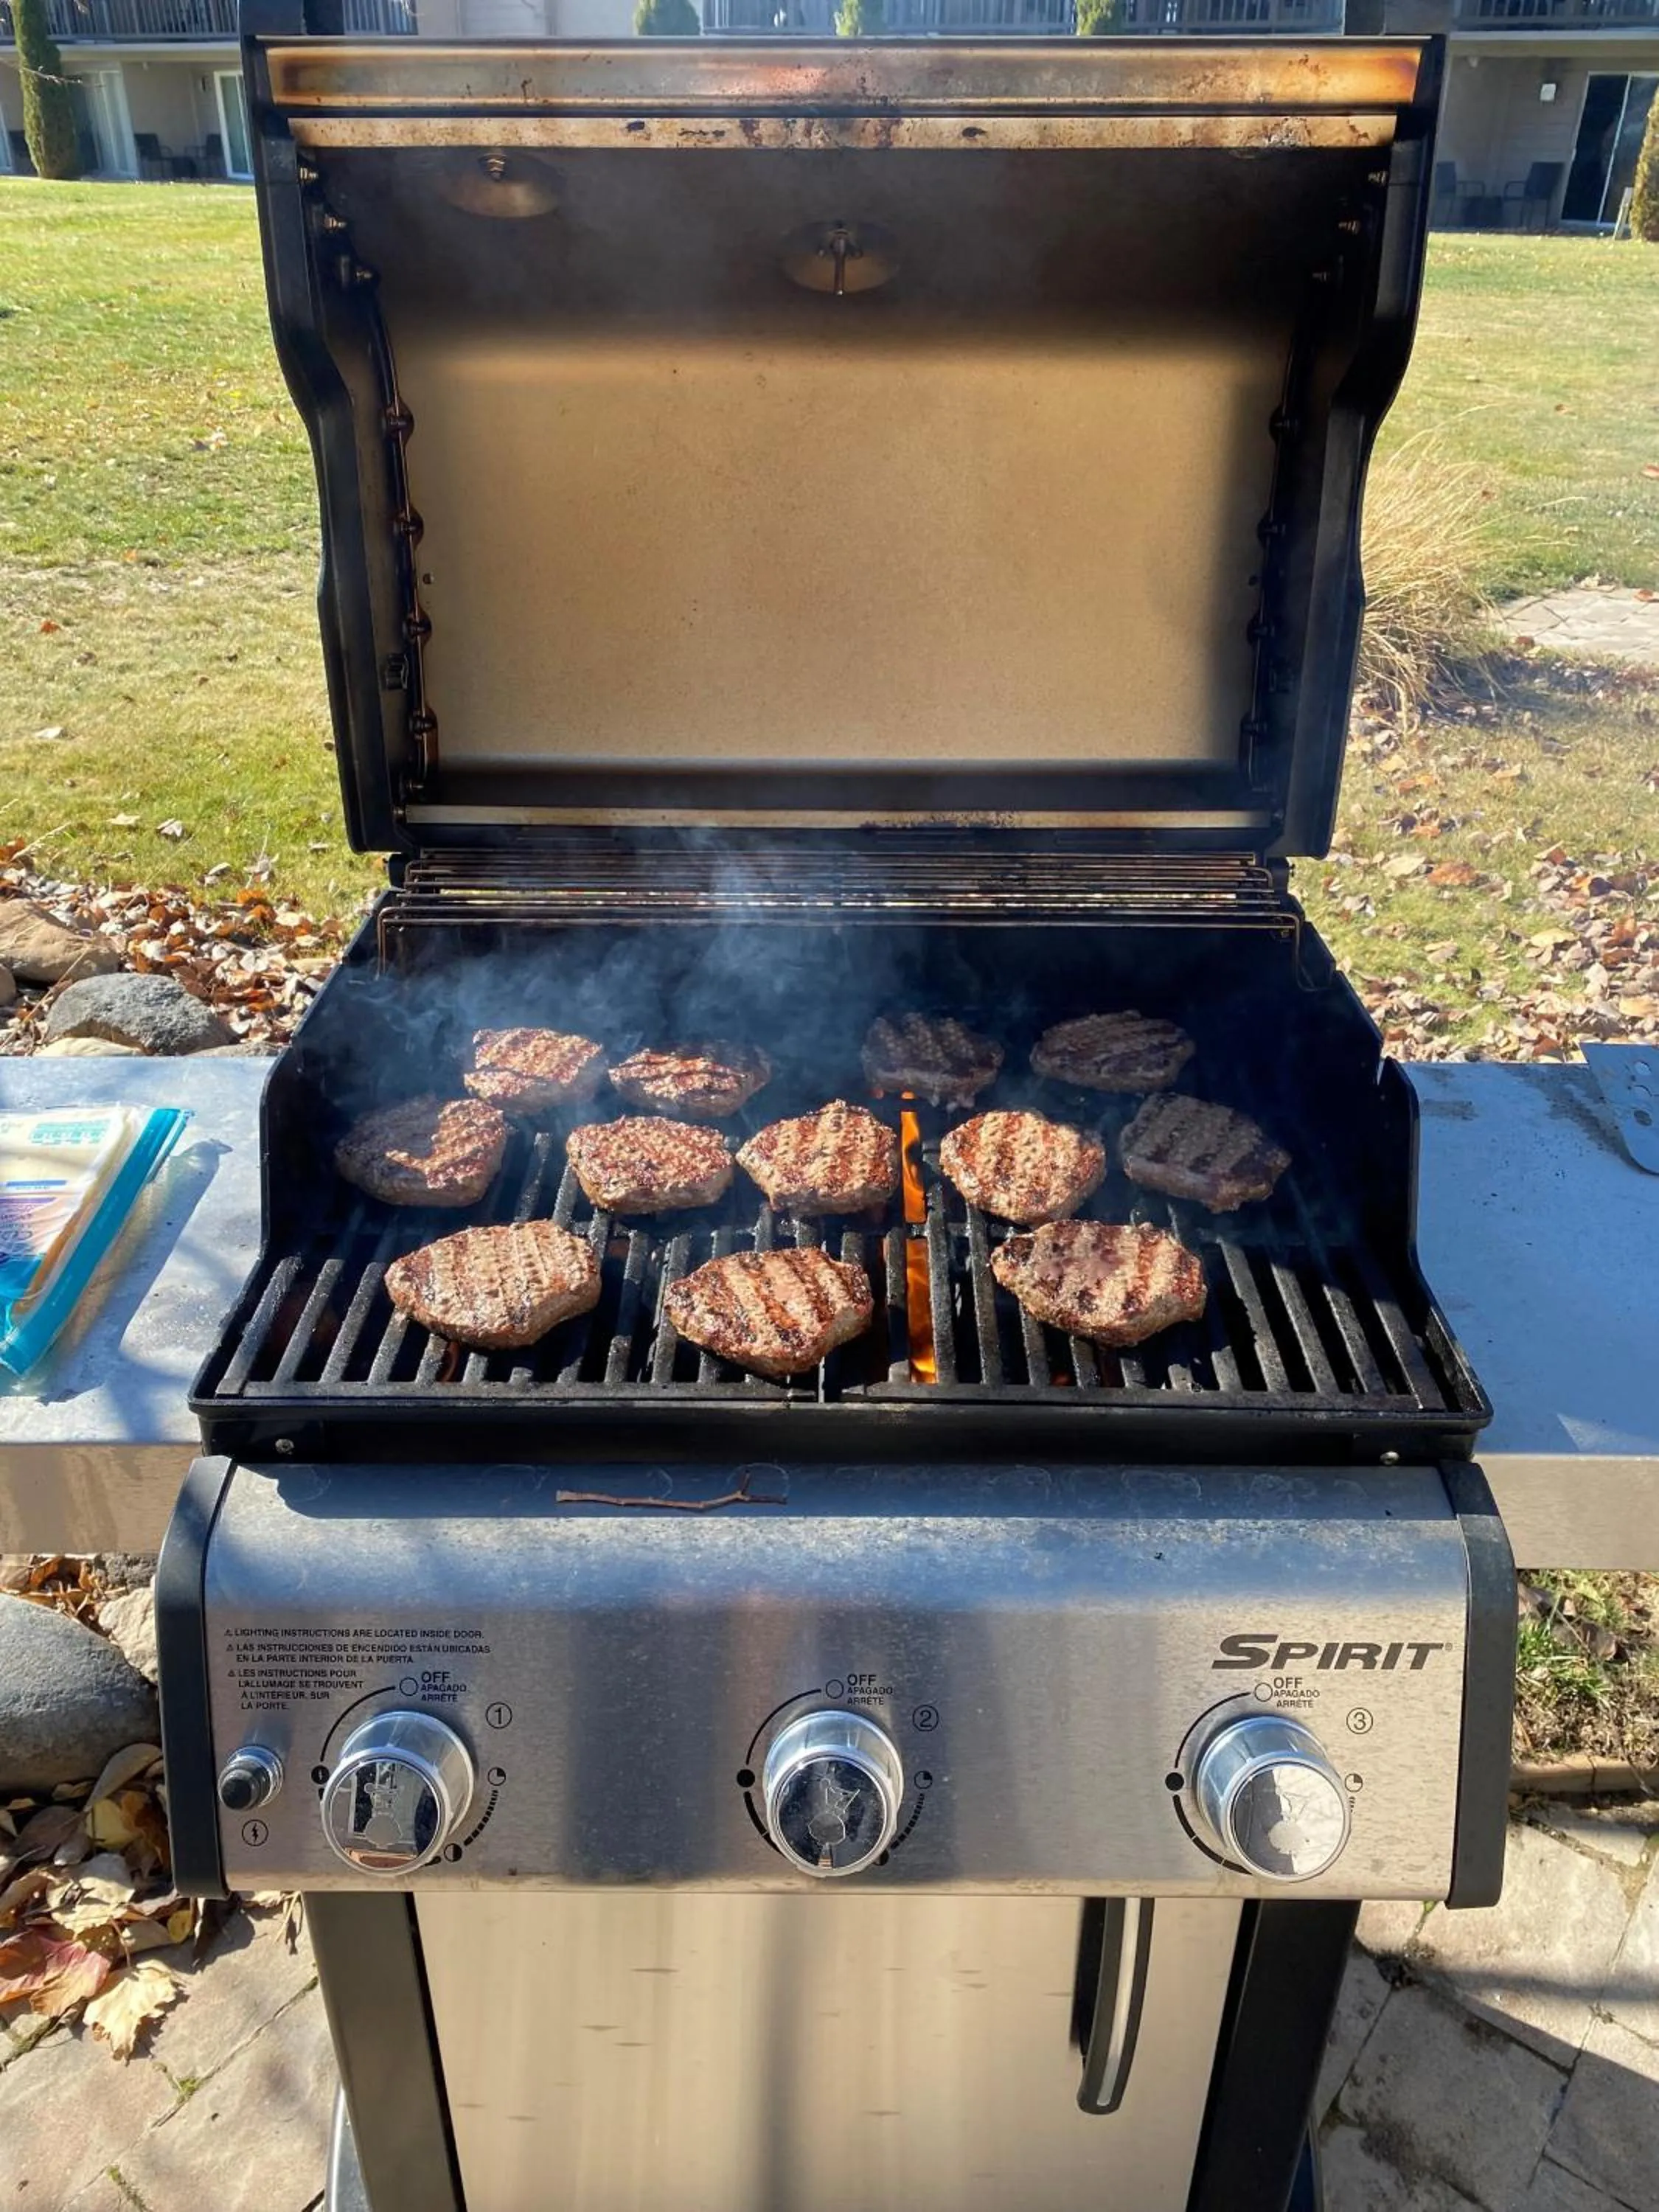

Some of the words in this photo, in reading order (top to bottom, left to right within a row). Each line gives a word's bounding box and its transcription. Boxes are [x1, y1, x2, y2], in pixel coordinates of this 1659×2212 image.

[234, 1629, 279, 1638] LIGHTING
[282, 1629, 350, 1638] INSTRUCTIONS
[353, 1630, 372, 1638] ARE
[375, 1630, 417, 1638] LOCATED
[420, 1630, 451, 1638] INSIDE
[236, 1644, 254, 1652] LAS
[258, 1644, 333, 1652] INSTRUCCIONES
[336, 1644, 349, 1652] DE
[352, 1644, 408, 1652] ENCENDIDO
[442, 1645, 490, 1654] UBICADAS
[1211, 1634, 1444, 1670] SPIRIT
[236, 1655, 249, 1663] EN
[251, 1655, 265, 1663] LA
[267, 1655, 296, 1663] PARTE
[299, 1655, 344, 1663] INTERIOR
[361, 1655, 374, 1663] LA
[238, 1669, 256, 1677] LES
[258, 1669, 327, 1678] INSTRUCTIONS
[330, 1669, 357, 1677] POUR
[421, 1671, 451, 1683] OFF
[312, 1680, 364, 1689] TROUVENT
[848, 1674, 877, 1686] OFF
[1273, 1677, 1303, 1688] OFF
[421, 1684, 467, 1692] APAGADO
[847, 1686, 893, 1694] APAGADO
[1273, 1689, 1320, 1698] APAGADO
[241, 1702, 253, 1710] LA
